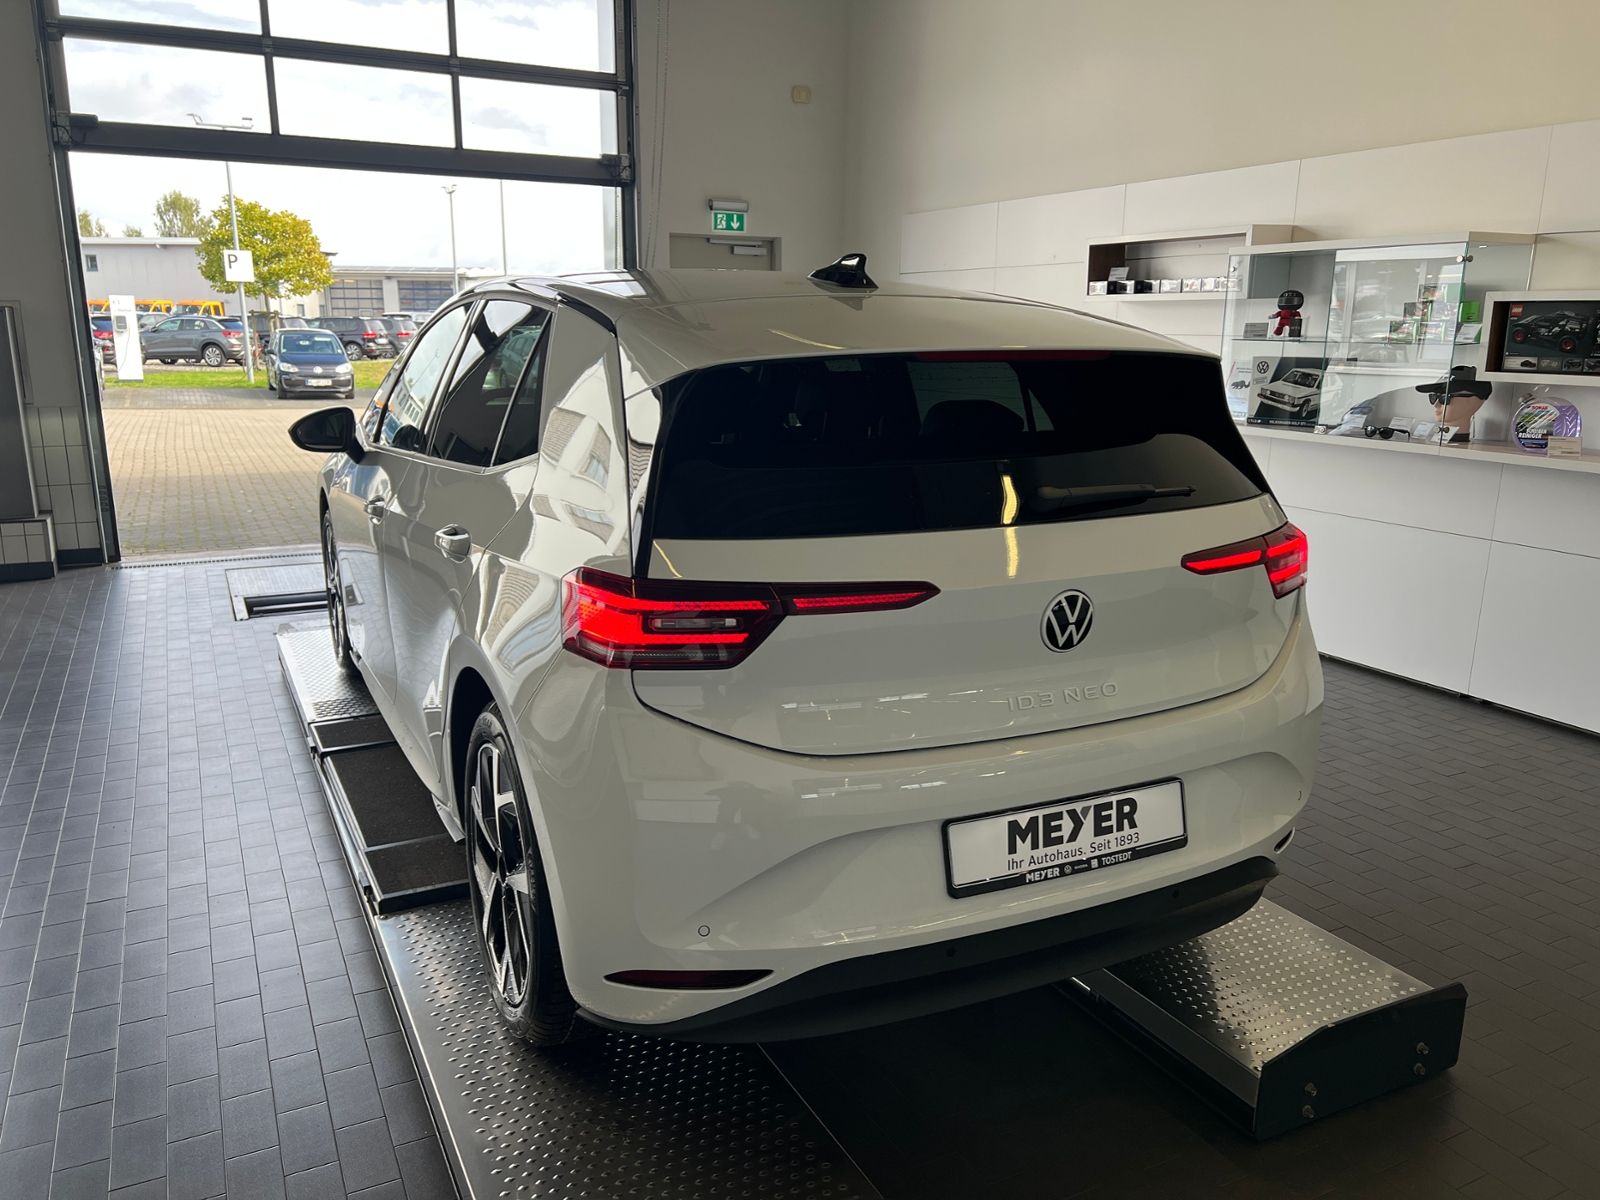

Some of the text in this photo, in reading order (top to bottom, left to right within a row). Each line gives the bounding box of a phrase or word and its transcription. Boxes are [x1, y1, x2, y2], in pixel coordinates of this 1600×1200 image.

[228, 253, 238, 269] P
[1062, 682, 1119, 705] NEO
[1007, 797, 1138, 855] MEYER
[1007, 858, 1025, 872] Ihr
[1027, 848, 1087, 867] Autohaus.
[1089, 839, 1112, 854] Seit
[1114, 832, 1140, 848] 1893
[1025, 851, 1133, 883] MEYER TOSTEDT
